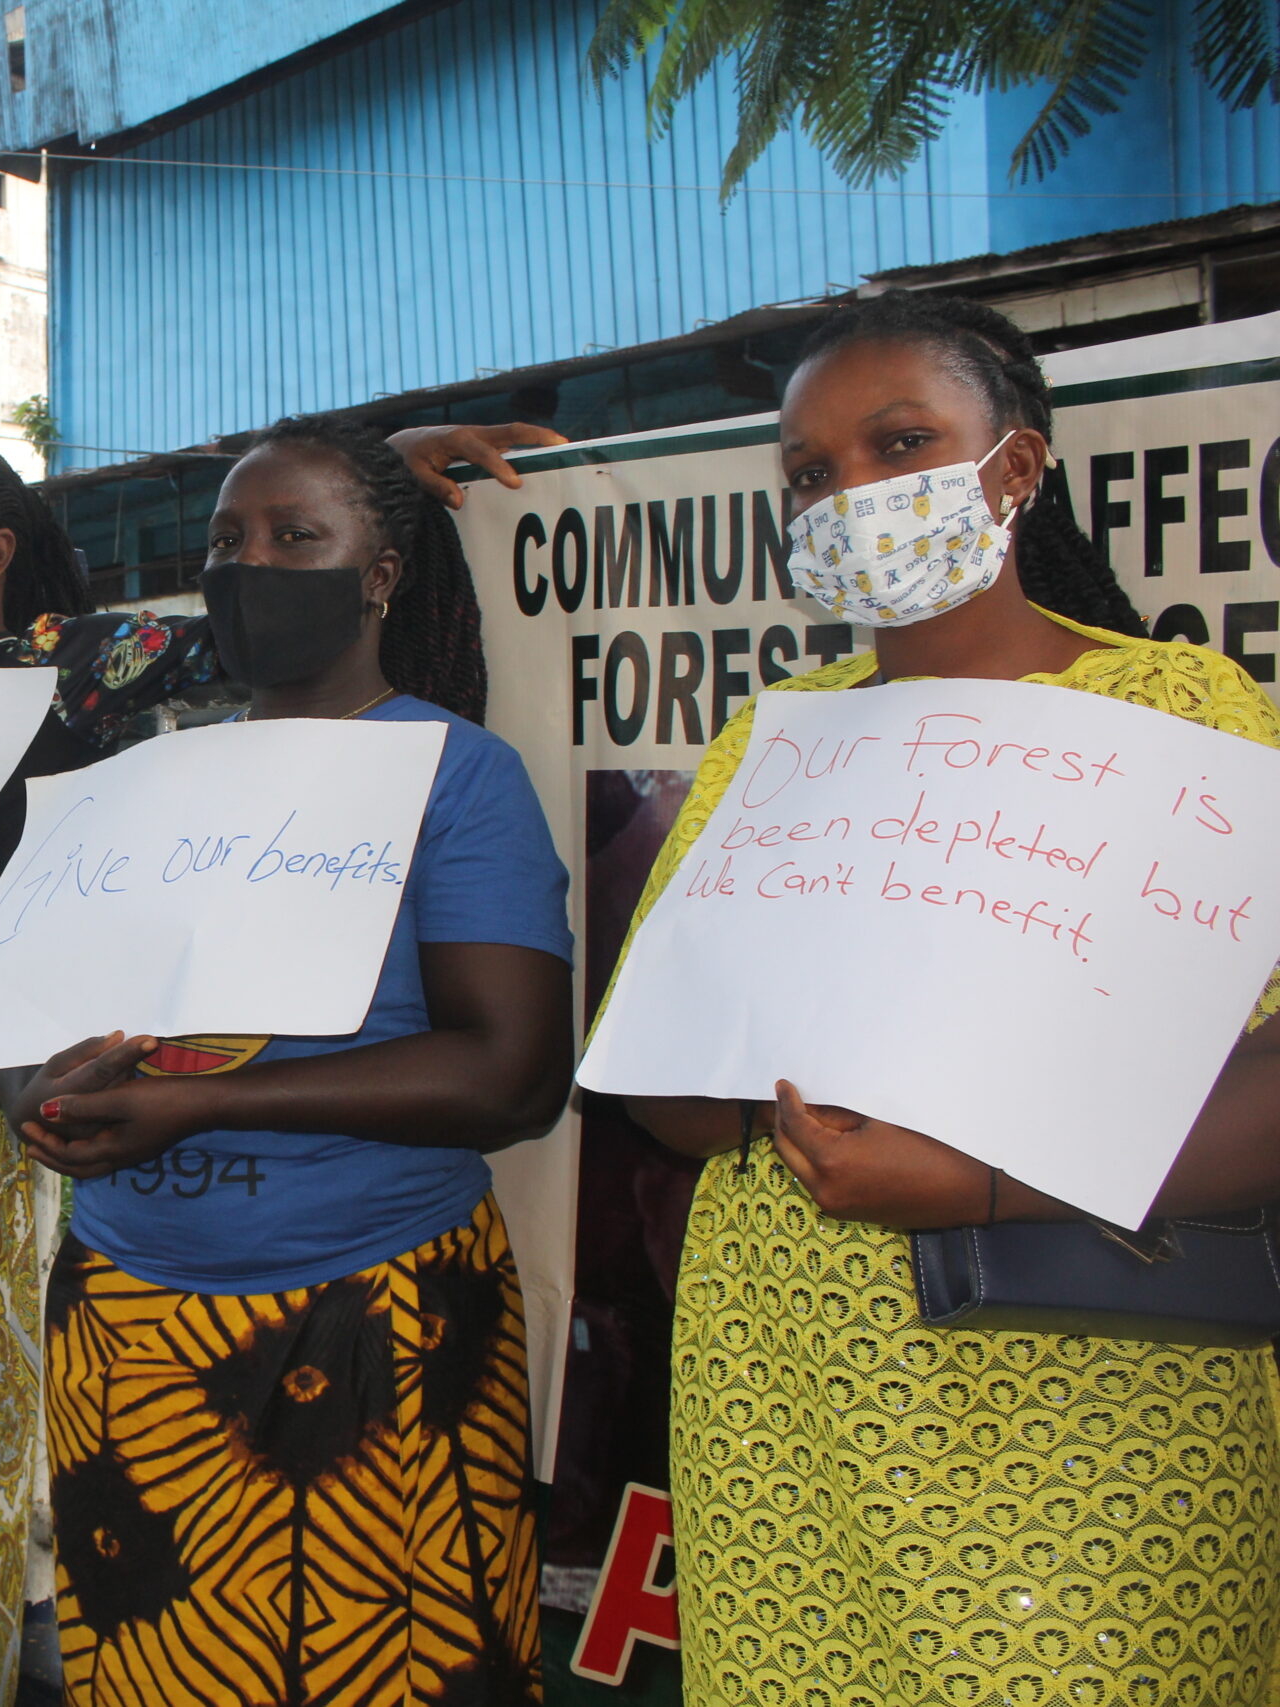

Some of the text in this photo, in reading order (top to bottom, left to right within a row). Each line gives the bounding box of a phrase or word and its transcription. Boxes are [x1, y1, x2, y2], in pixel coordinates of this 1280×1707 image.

[513, 487, 820, 617] COMMUN
[902, 713, 1128, 788] Forest
[1171, 774, 1235, 836] is
[719, 790, 1252, 943] been depleted but
